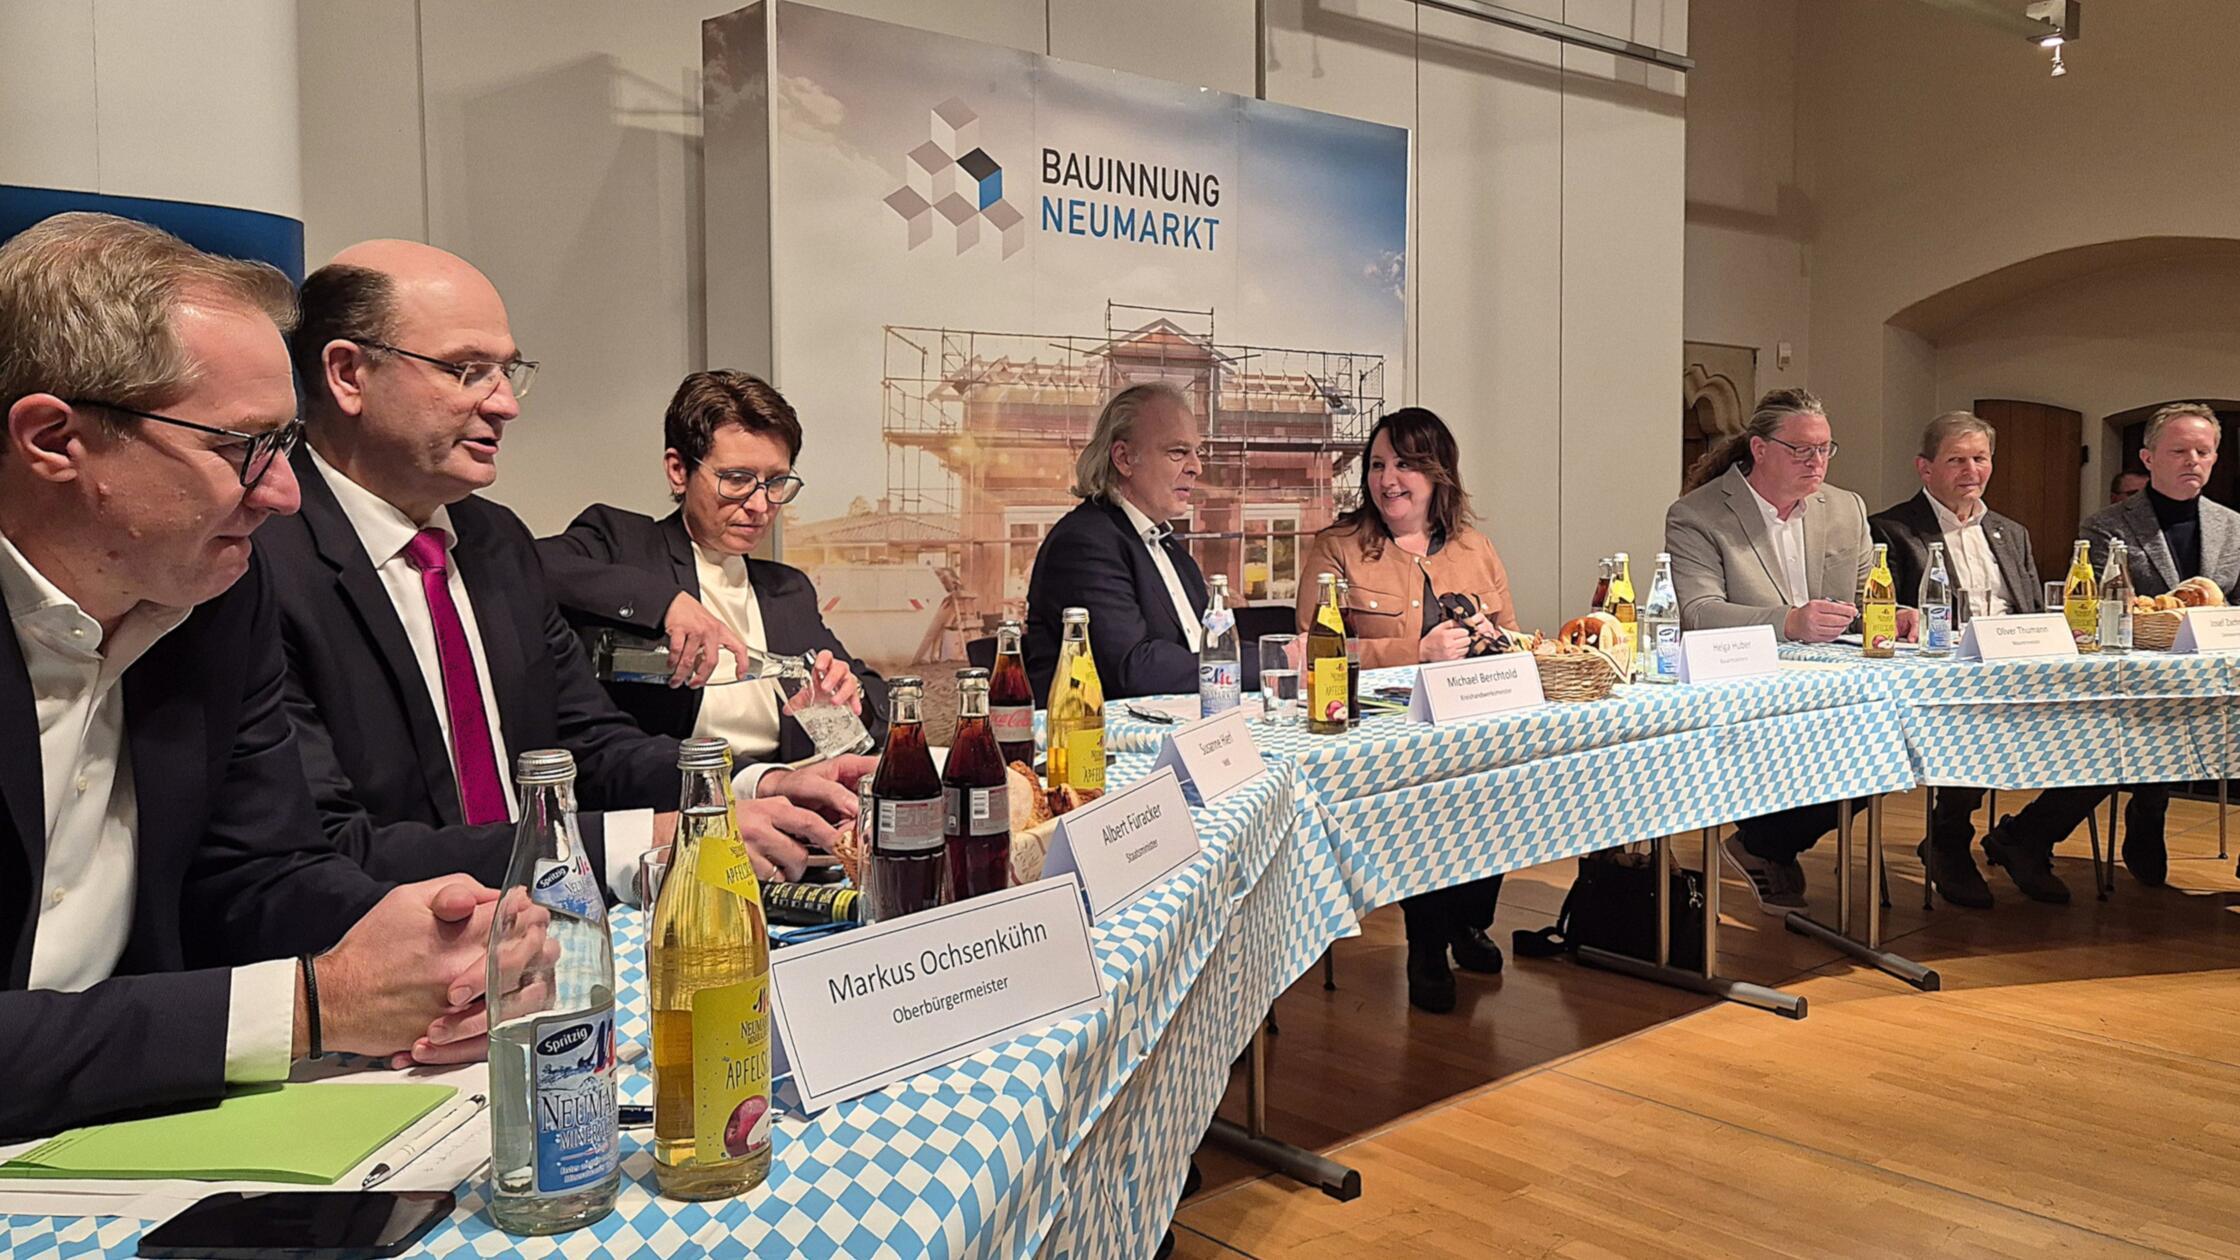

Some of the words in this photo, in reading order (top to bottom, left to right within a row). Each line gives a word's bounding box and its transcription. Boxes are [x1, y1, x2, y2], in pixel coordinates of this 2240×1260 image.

[1042, 148, 1220, 207] BAUINNUNG
[1042, 195, 1220, 251] NEUMARKT
[1446, 672, 1478, 688] Michael
[1479, 668, 1518, 684] Berchtold
[1101, 820, 1130, 846] Albert
[1126, 804, 1162, 832] Füracker
[540, 867, 567, 888] Spritzig
[828, 961, 915, 1004] Markus
[920, 921, 1048, 975] Ochsenkühn
[893, 976, 1009, 1024] Oberbürgermeister
[545, 1027, 588, 1053] Spritzig
